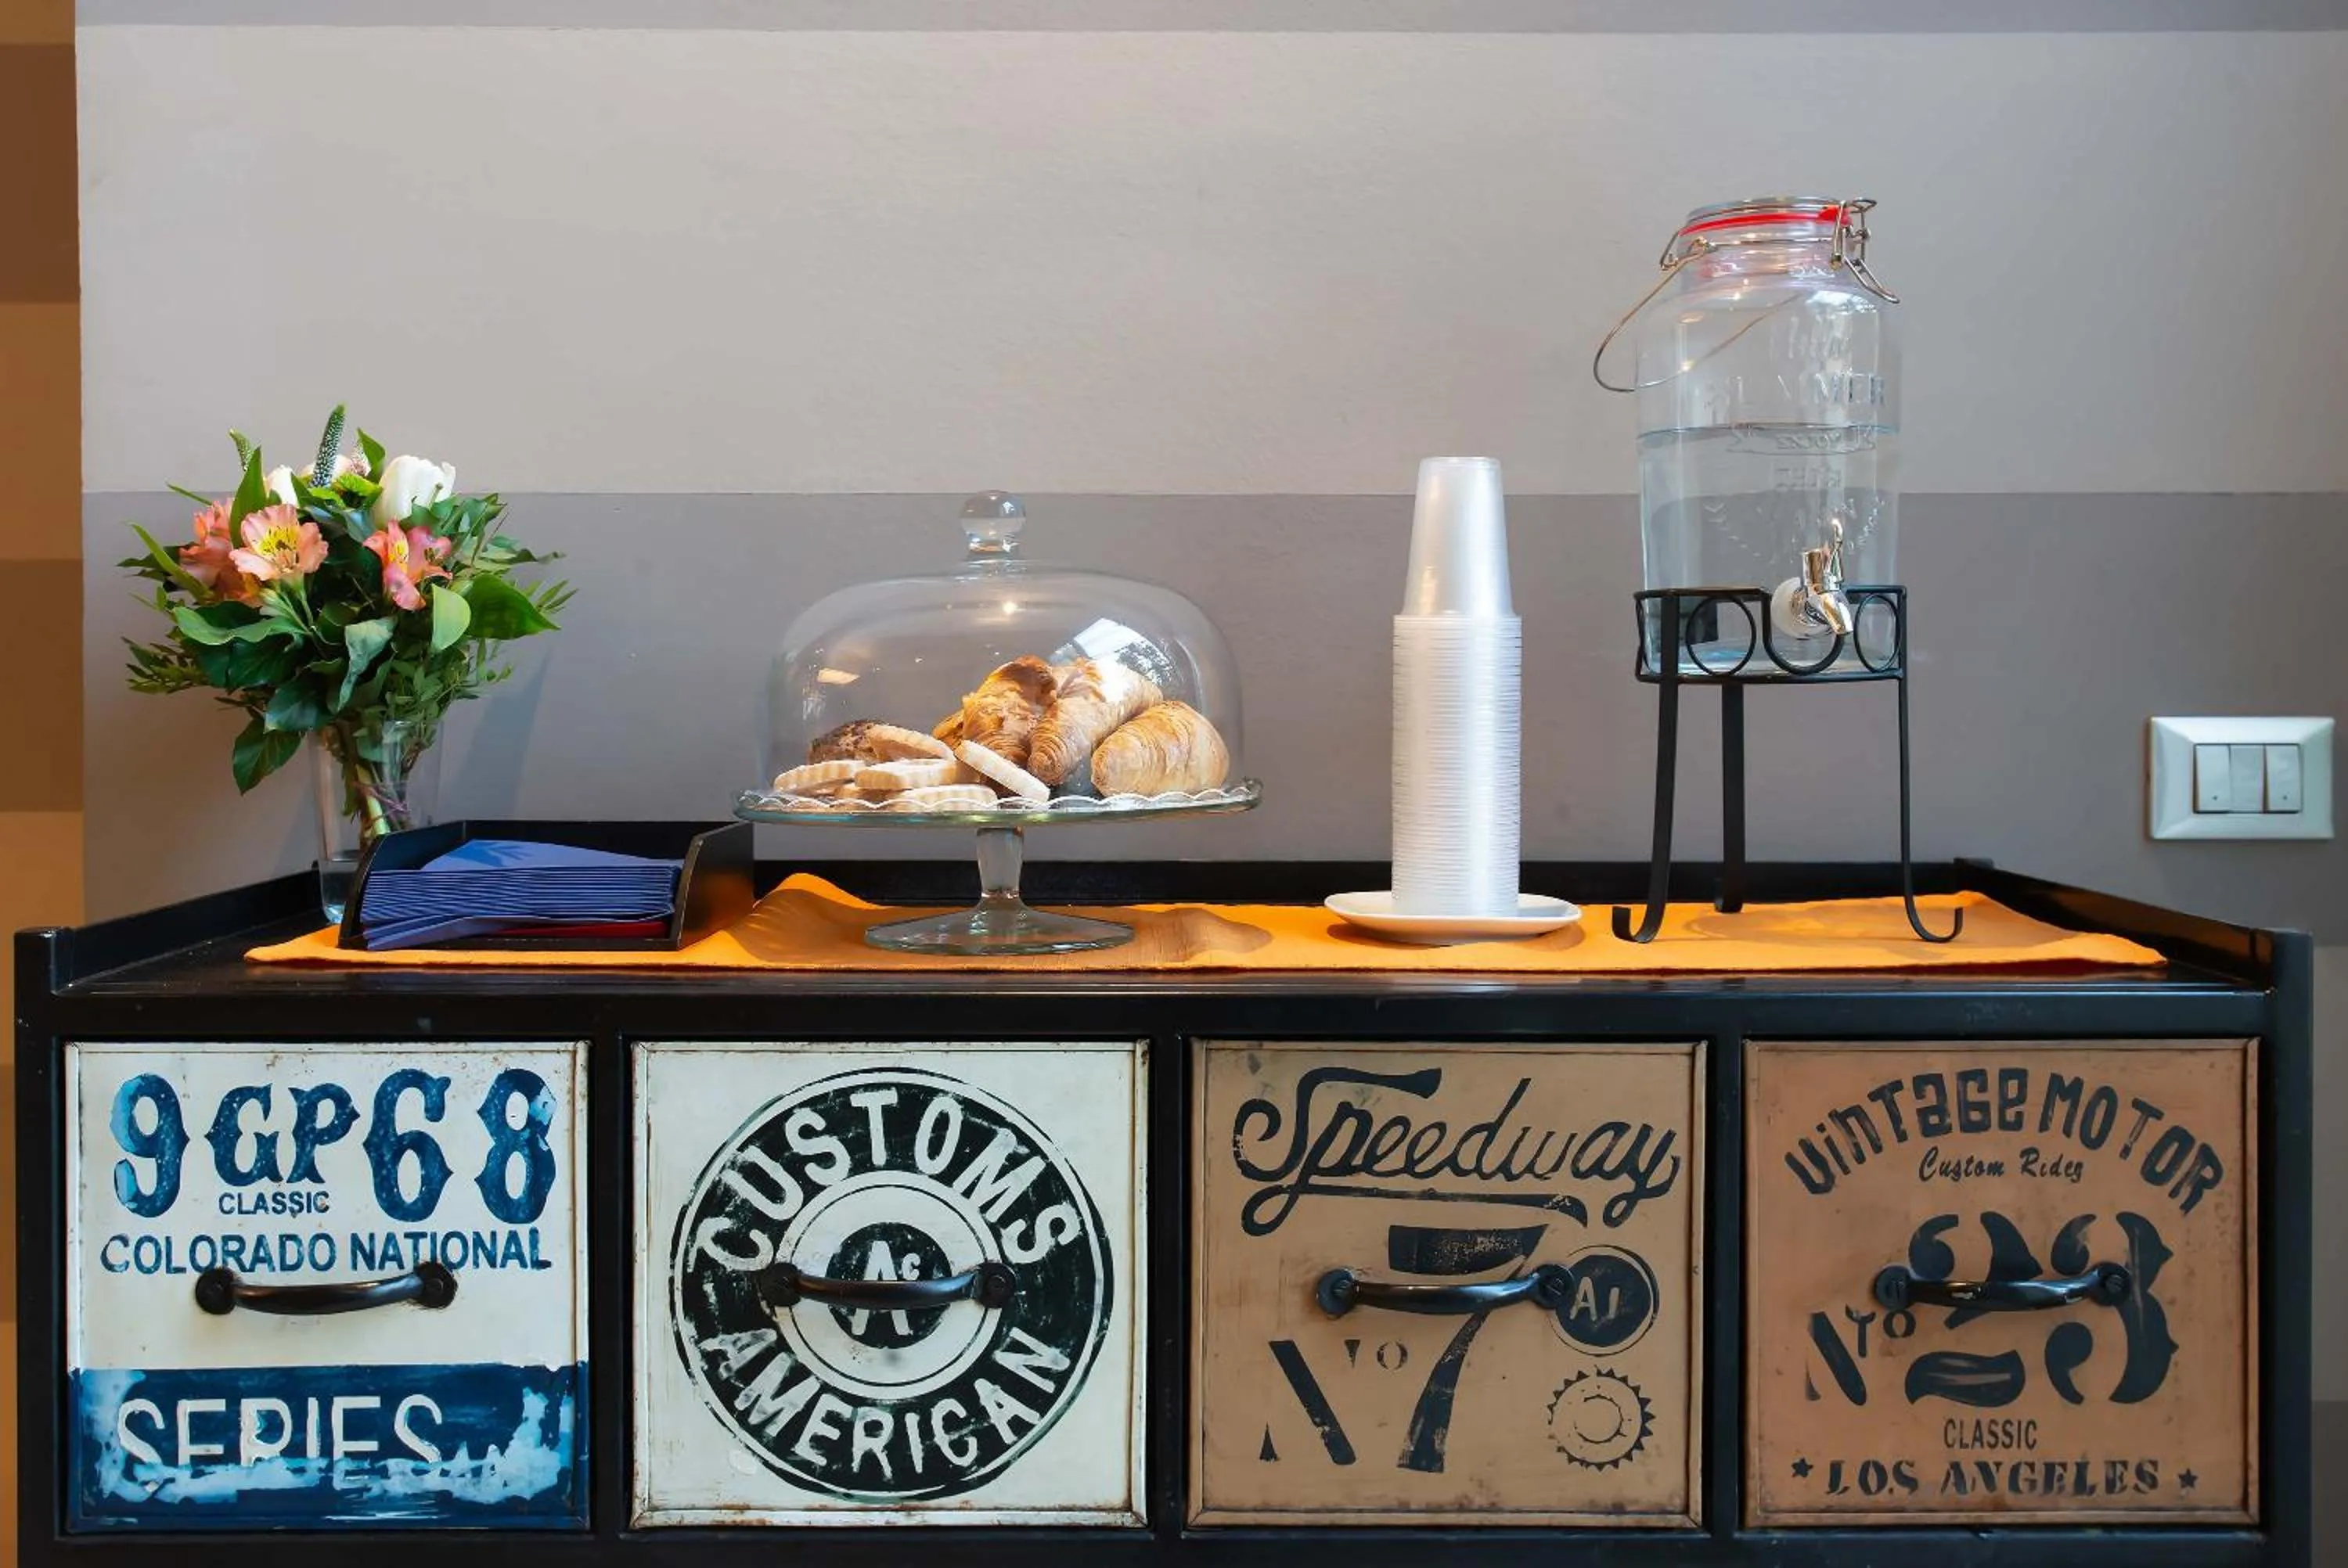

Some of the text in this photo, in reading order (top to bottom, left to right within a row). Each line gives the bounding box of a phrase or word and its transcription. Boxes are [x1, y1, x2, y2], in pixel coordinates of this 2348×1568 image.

[1232, 1066, 1680, 1237] Speedway
[1918, 1145, 2084, 1184] Custom Rides
[2037, 1073, 2224, 1215] MOTOR
[218, 1191, 330, 1214] CLASSIC
[686, 1088, 1082, 1274] CUSTOMS
[100, 1227, 552, 1274] COLORADO NATIONAL
[699, 1327, 1071, 1483] AMERICAN
[1943, 1418, 2038, 1450] CLASSIC
[1824, 1459, 2160, 1495] LOS ANGELES
